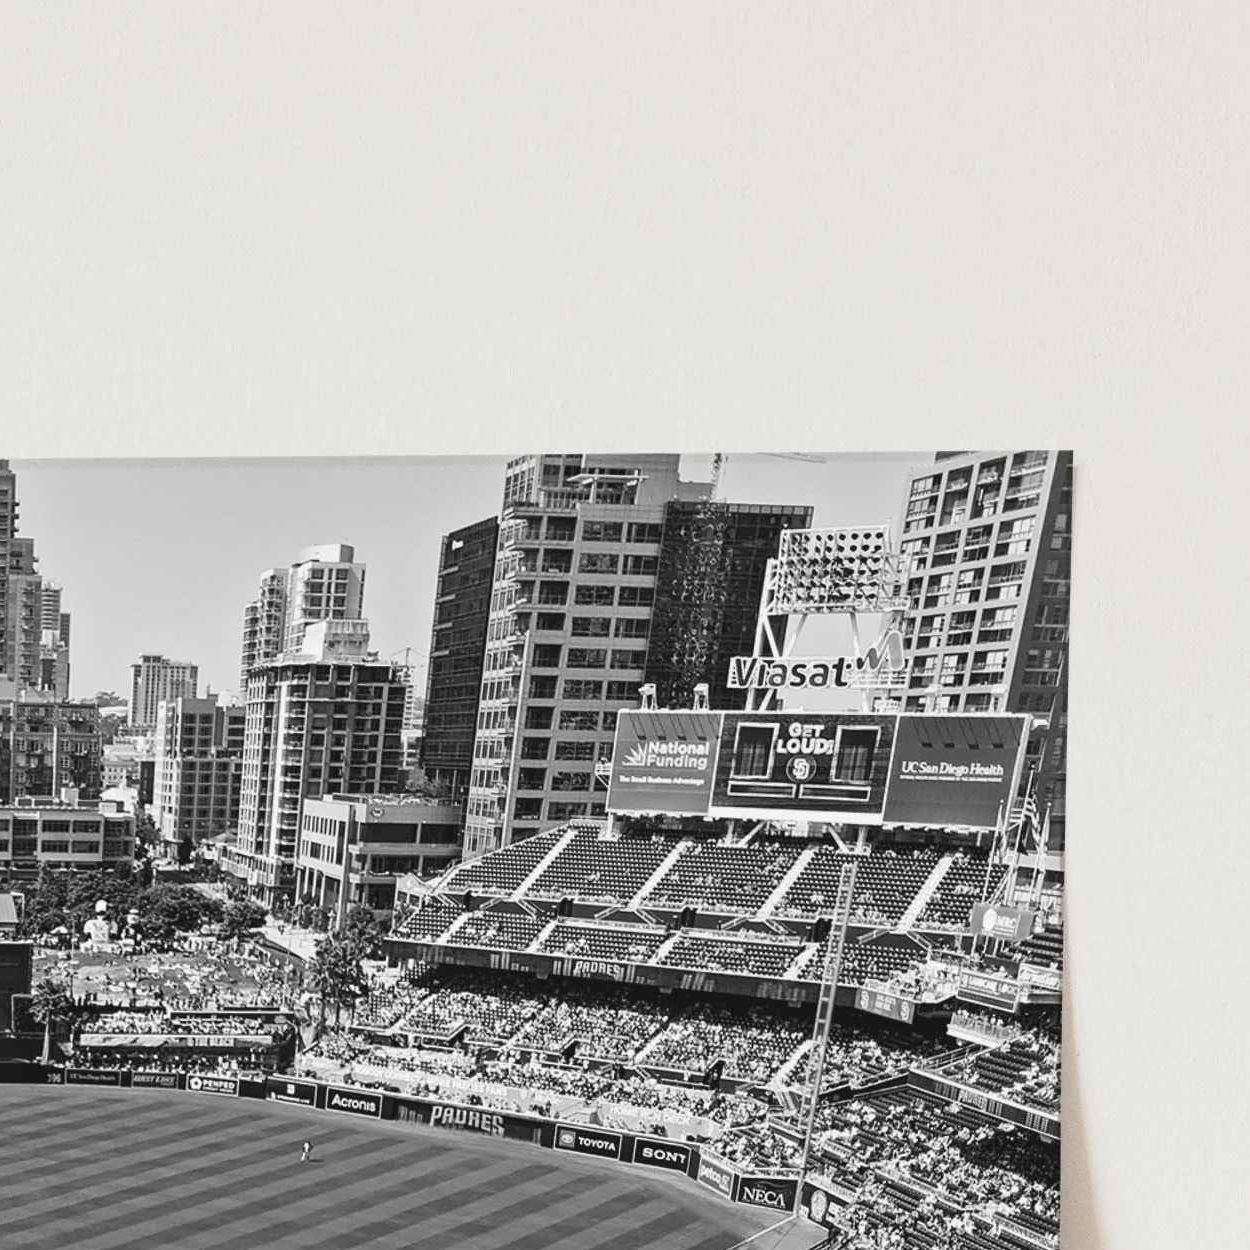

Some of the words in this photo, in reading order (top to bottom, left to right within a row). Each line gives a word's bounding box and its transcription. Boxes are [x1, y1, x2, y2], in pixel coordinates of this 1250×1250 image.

[735, 657, 849, 688] Viasat
[788, 721, 825, 738] GET
[648, 741, 710, 756] National
[776, 737, 834, 755] LOUD!
[646, 754, 708, 771] Funding
[901, 761, 918, 773] UC
[918, 761, 938, 774] San
[939, 762, 969, 777] Diego
[969, 762, 1004, 776] Health
[573, 960, 623, 982] PADRES
[331, 1093, 377, 1112] Acronis
[430, 1105, 506, 1138] PADRES
[578, 1136, 616, 1152] TOYOTA
[642, 1147, 687, 1164] SONY
[742, 1186, 786, 1209] NECA
